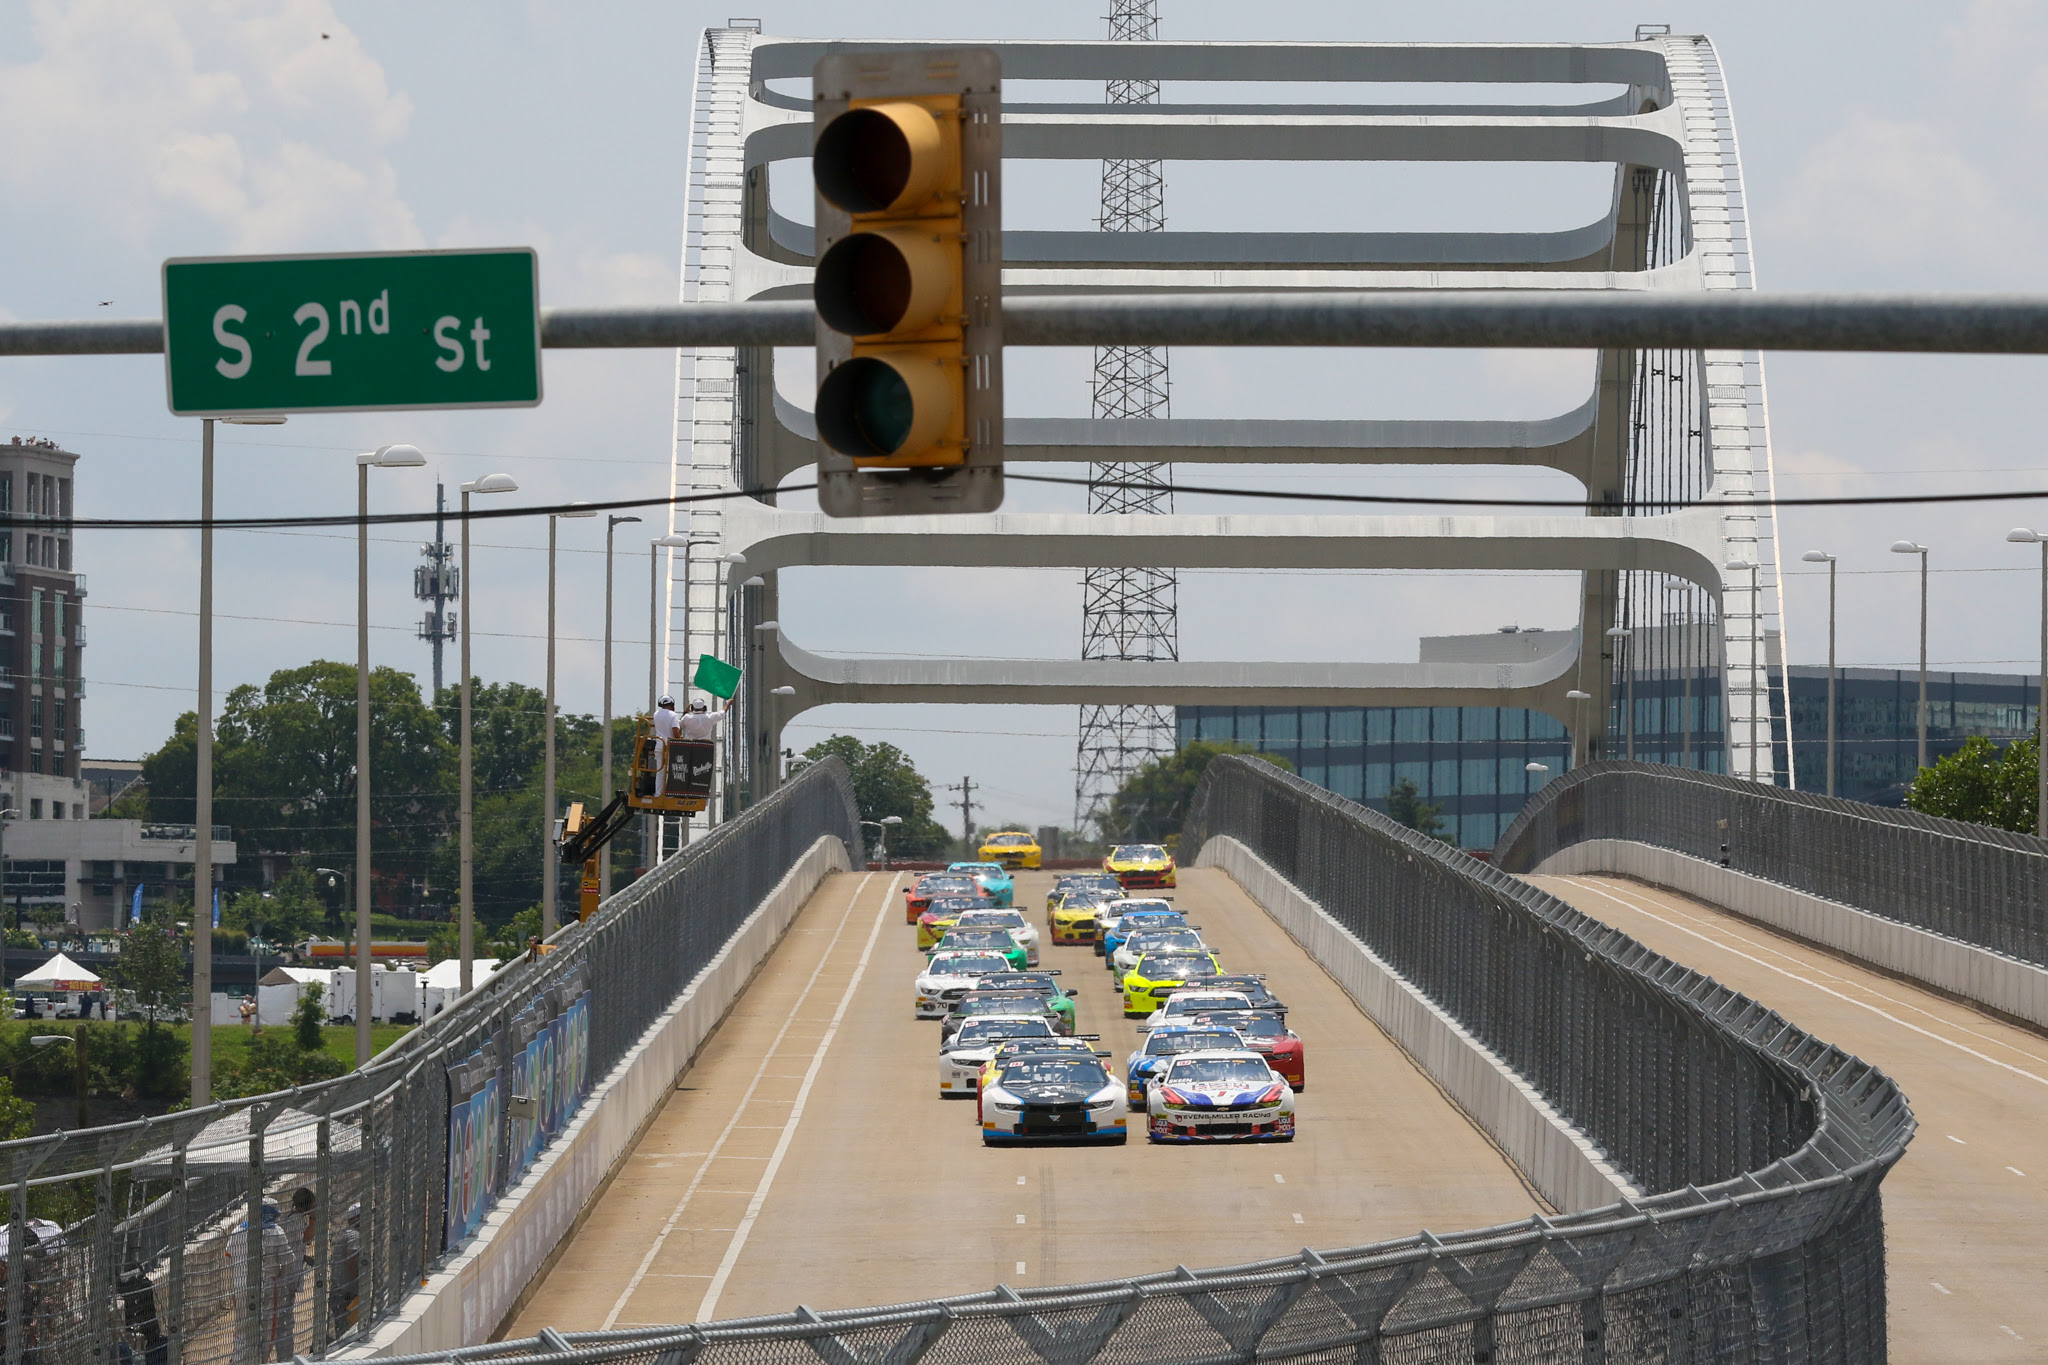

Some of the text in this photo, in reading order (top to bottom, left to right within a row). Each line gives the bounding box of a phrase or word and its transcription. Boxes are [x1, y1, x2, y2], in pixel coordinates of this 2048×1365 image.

[212, 288, 492, 379] S 2nd St
